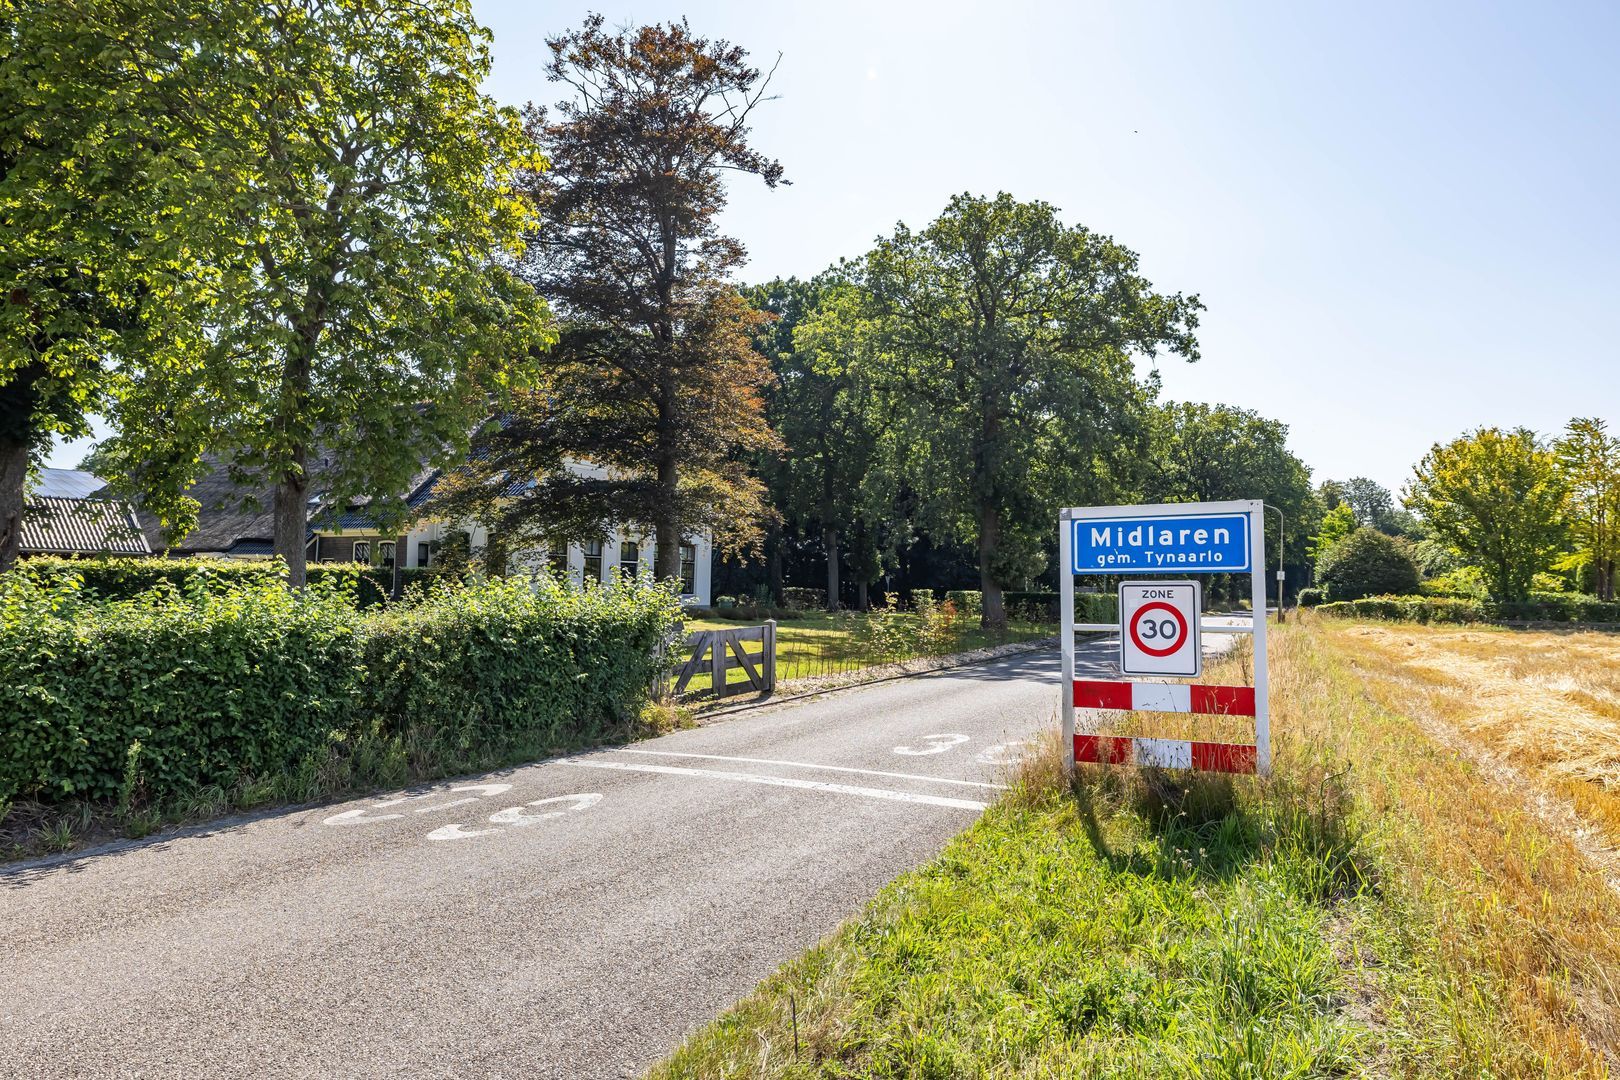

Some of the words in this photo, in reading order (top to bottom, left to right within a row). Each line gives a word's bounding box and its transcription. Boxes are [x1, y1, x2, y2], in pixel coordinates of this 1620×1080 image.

[1091, 525, 1230, 548] Midlaren
[1097, 552, 1136, 567] gem.
[1144, 550, 1223, 565] Tynaarlo
[1142, 590, 1174, 599] ZONE
[1141, 619, 1177, 640] 30
